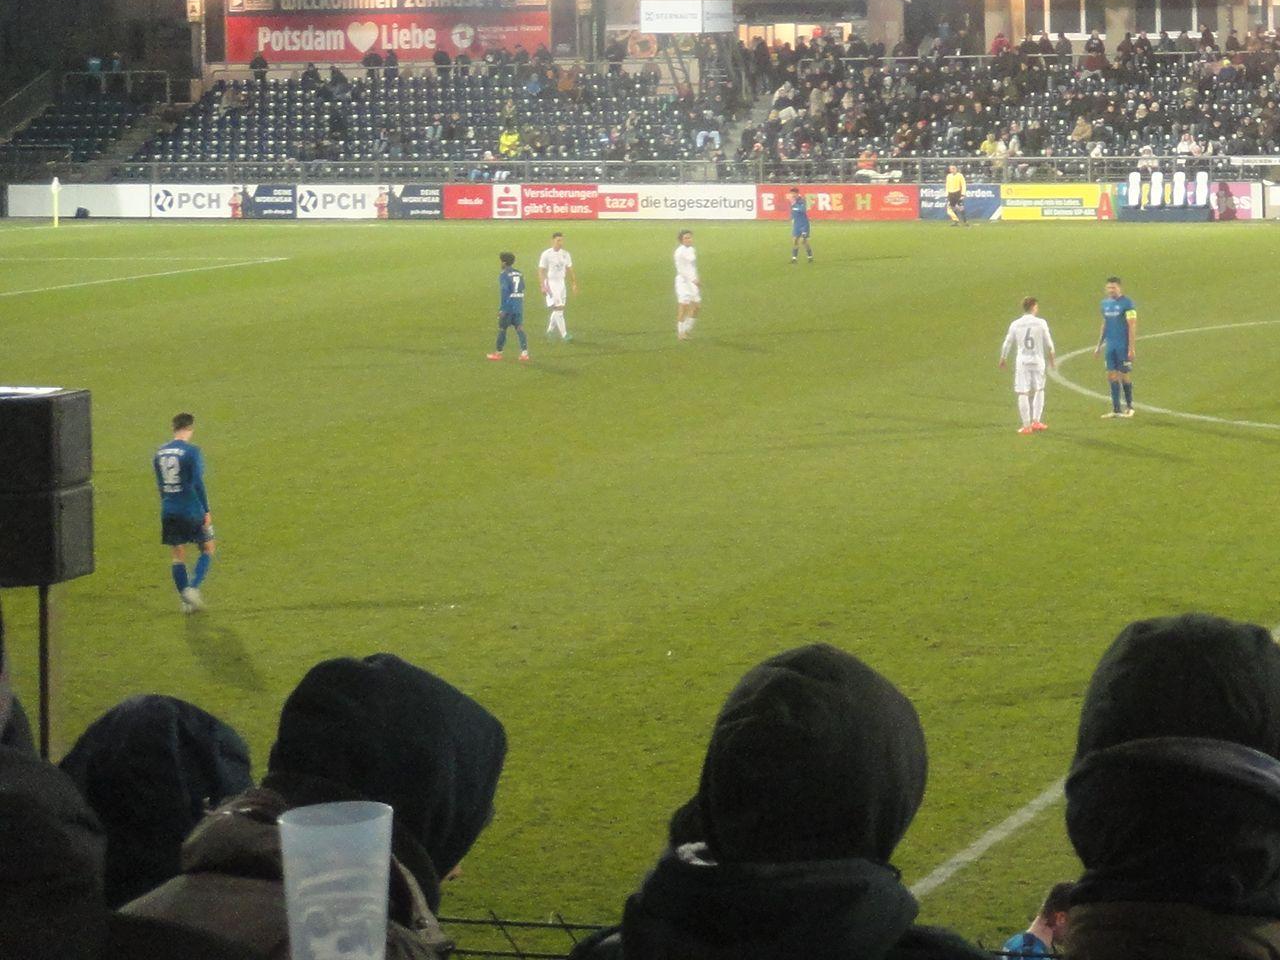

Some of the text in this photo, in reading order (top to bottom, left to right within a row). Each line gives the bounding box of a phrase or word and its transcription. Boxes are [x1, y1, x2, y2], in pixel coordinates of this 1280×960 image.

[258, 22, 437, 52] Potsdam Liebe
[178, 192, 221, 209] PCH
[321, 192, 367, 210] PCH
[524, 187, 599, 201] Versicherungen
[524, 202, 593, 216] gibt's bei uns.
[640, 196, 661, 209] die
[664, 195, 755, 212] tageszeitung
[1024, 327, 1035, 350] 6
